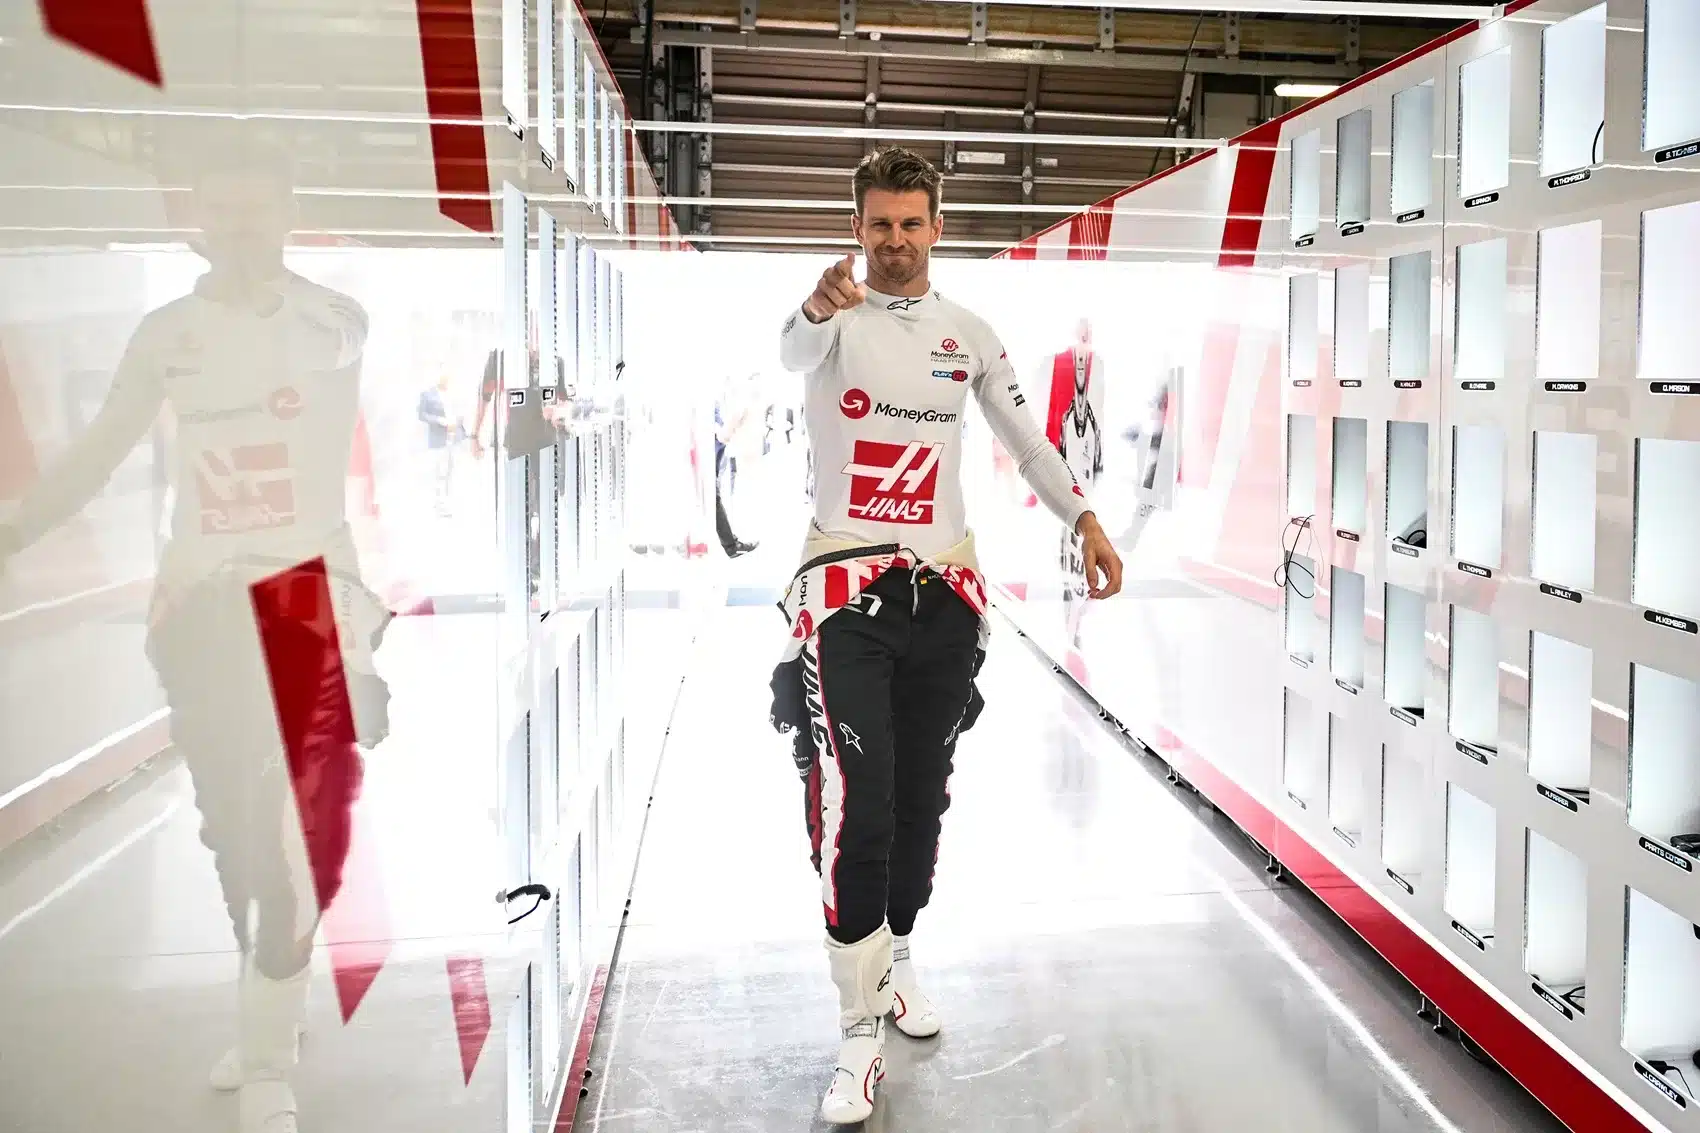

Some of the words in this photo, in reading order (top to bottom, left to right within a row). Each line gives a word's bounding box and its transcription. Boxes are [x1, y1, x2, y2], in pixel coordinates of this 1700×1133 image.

[930, 351, 969, 360] MoneyGram
[874, 403, 956, 423] MoneyGram
[849, 496, 934, 520] HAAS
[1655, 614, 1688, 630] M.KEMBER
[1644, 840, 1665, 857] PARTS
